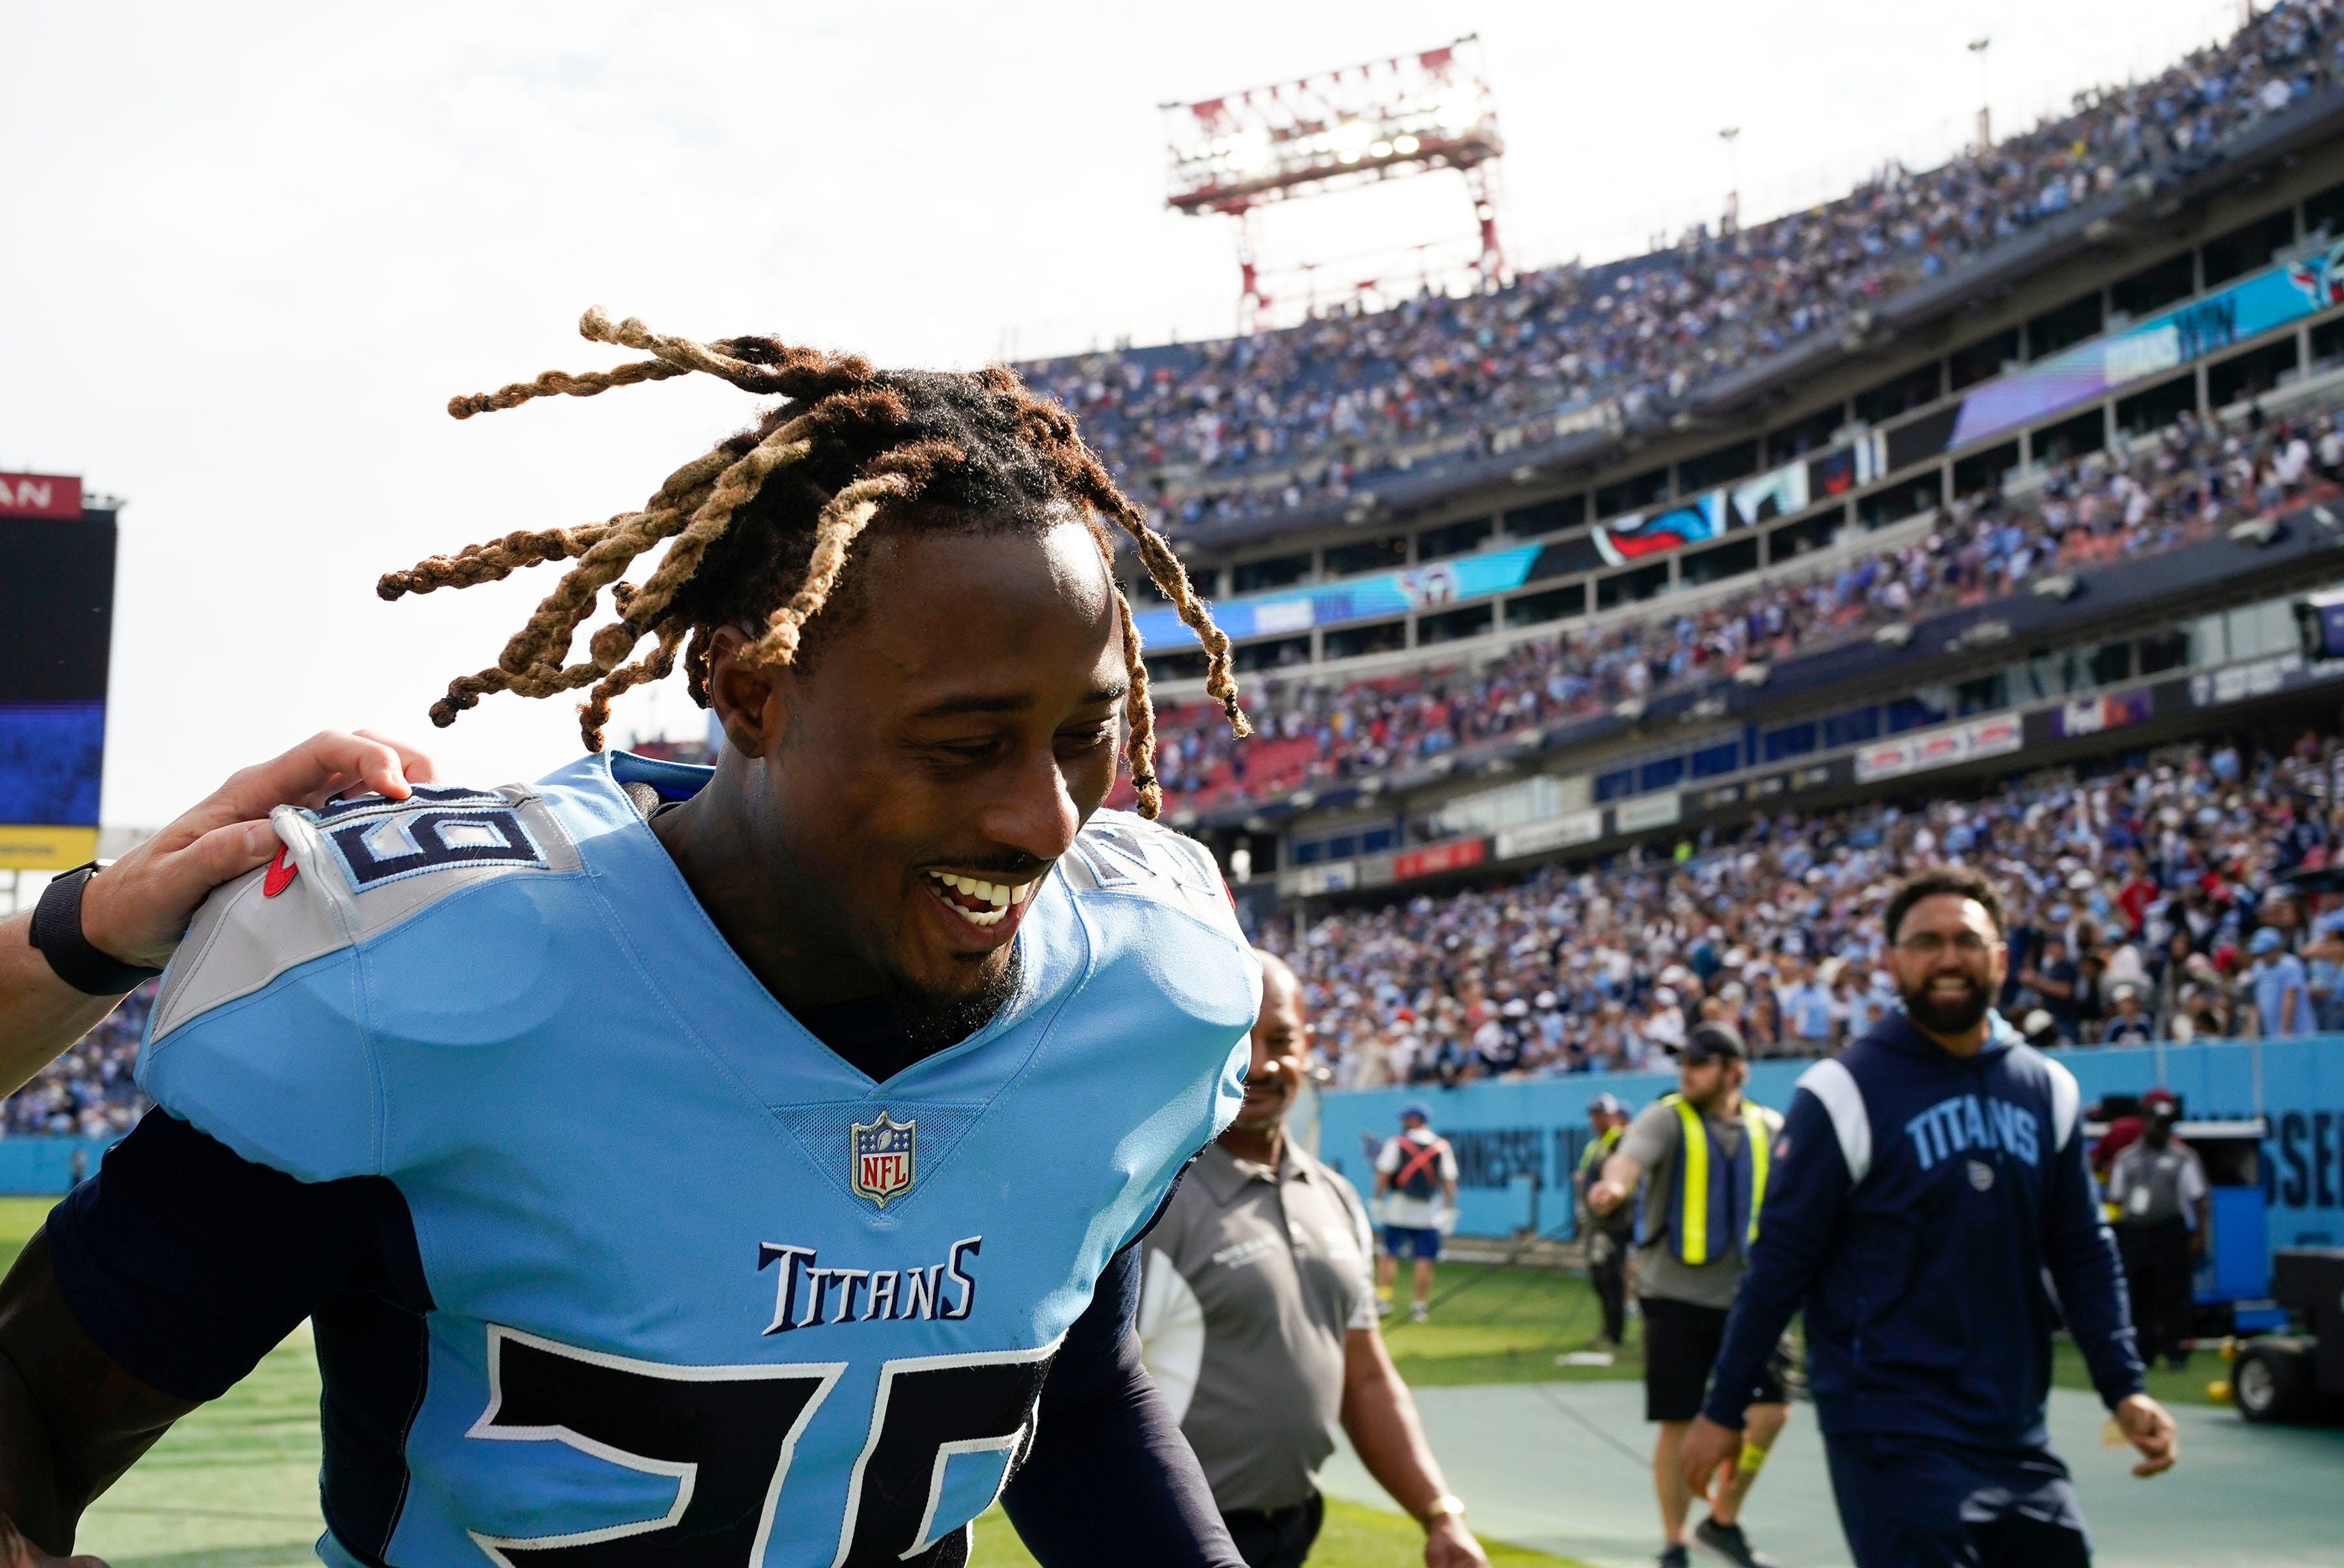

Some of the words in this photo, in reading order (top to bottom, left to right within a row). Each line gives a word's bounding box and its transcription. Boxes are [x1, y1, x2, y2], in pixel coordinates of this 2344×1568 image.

[1905, 1094, 2039, 1170] TITANS
[863, 1155, 906, 1190] NFL
[757, 1235, 983, 1336] TITANS
